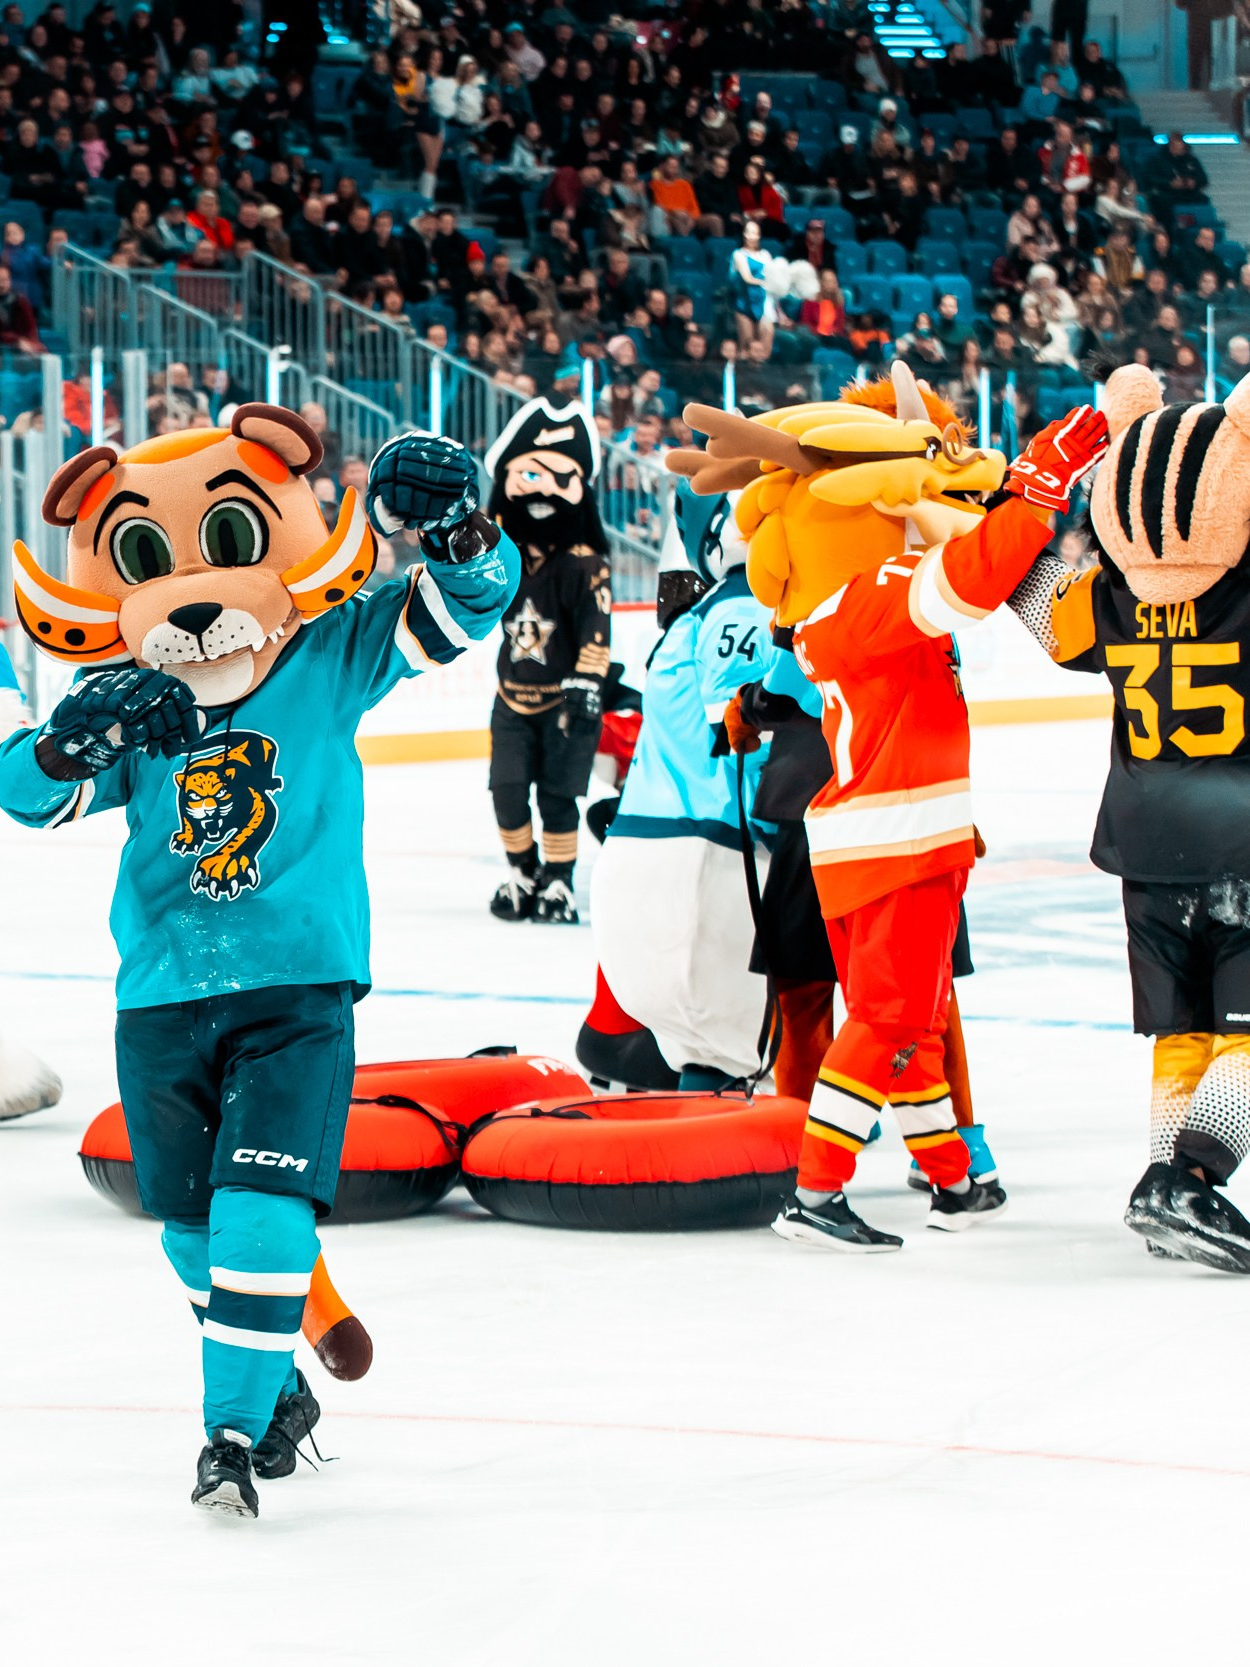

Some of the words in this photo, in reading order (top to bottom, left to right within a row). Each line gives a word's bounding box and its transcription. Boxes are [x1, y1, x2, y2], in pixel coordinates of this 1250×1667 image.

[1135, 600, 1198, 639] SEVA
[717, 623, 759, 662] 54
[1105, 641, 1245, 761] 35
[232, 1148, 309, 1173] CCM
